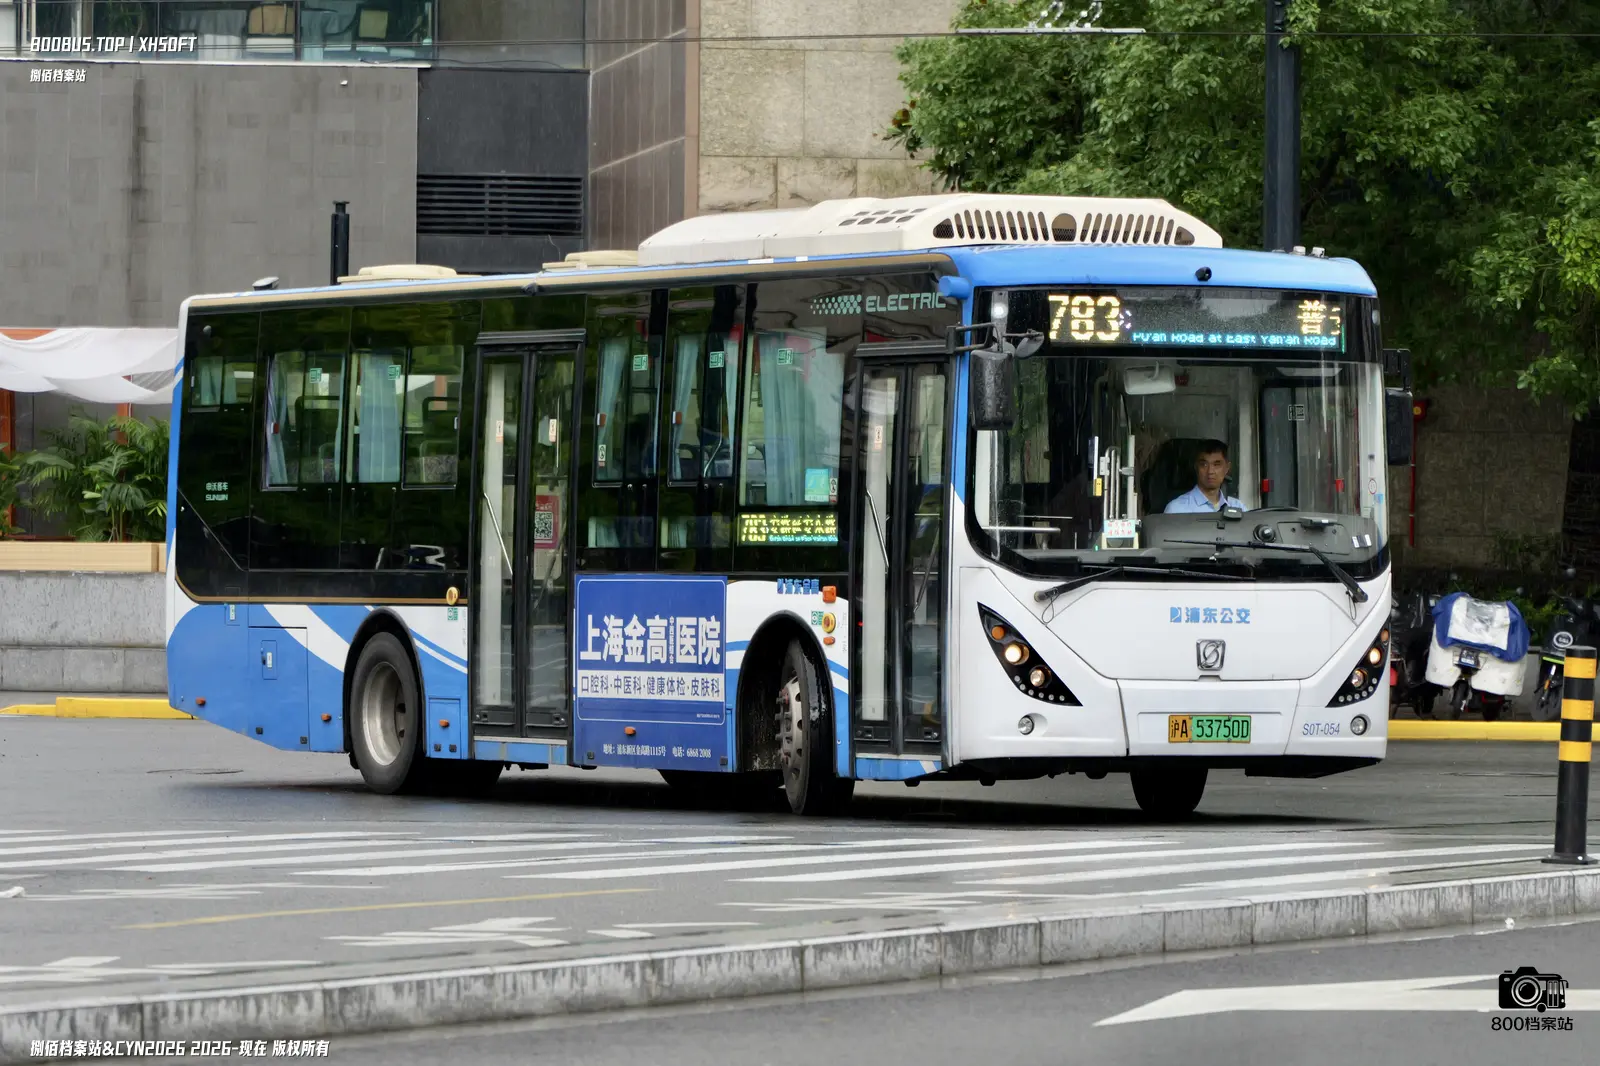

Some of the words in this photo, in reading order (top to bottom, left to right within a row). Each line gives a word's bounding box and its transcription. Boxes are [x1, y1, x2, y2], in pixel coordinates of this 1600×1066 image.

[865, 292, 946, 312] ELECTRIC
[1048, 294, 1120, 341] 783
[1208, 334, 1222, 343] at
[1185, 607, 1251, 624] 浦东公交
